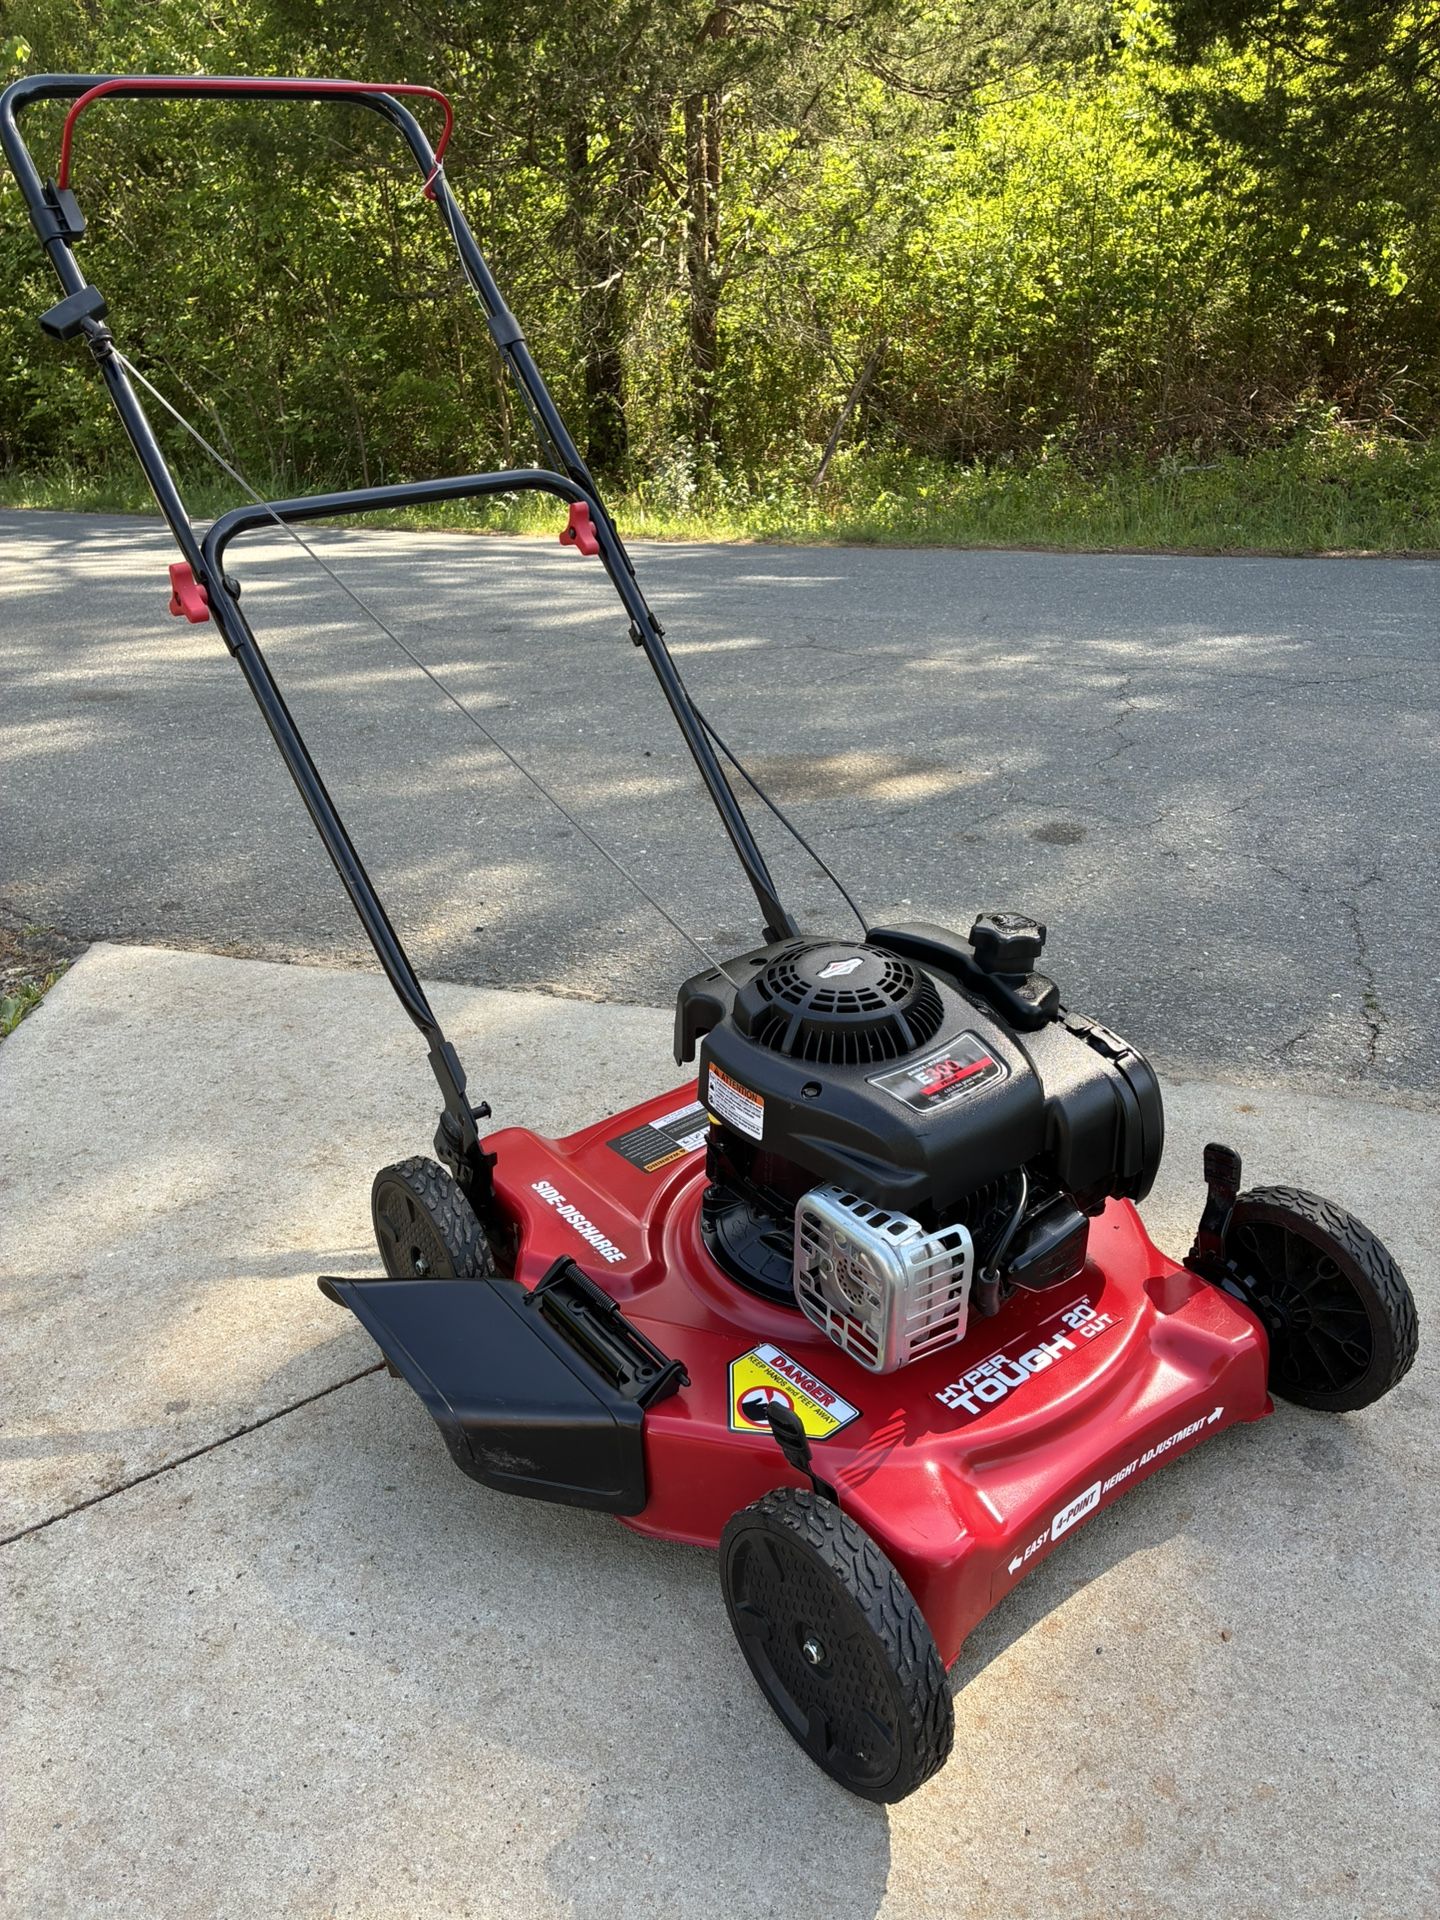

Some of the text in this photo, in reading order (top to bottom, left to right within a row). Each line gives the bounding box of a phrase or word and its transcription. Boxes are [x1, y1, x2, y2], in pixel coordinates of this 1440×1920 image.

[646, 1152, 680, 1170] WARNING
[531, 1180, 627, 1264] SIDE-DISCHARGE
[1080, 1313, 1114, 1338] CUT
[748, 1356, 836, 1425] KEEP HANDS and FEET AWAY
[769, 1355, 838, 1408] DANGER
[935, 1354, 1012, 1404] HYPER
[1024, 1416, 1207, 1561] EASY 4-POINT HEIGHT ADJUSTMENT
